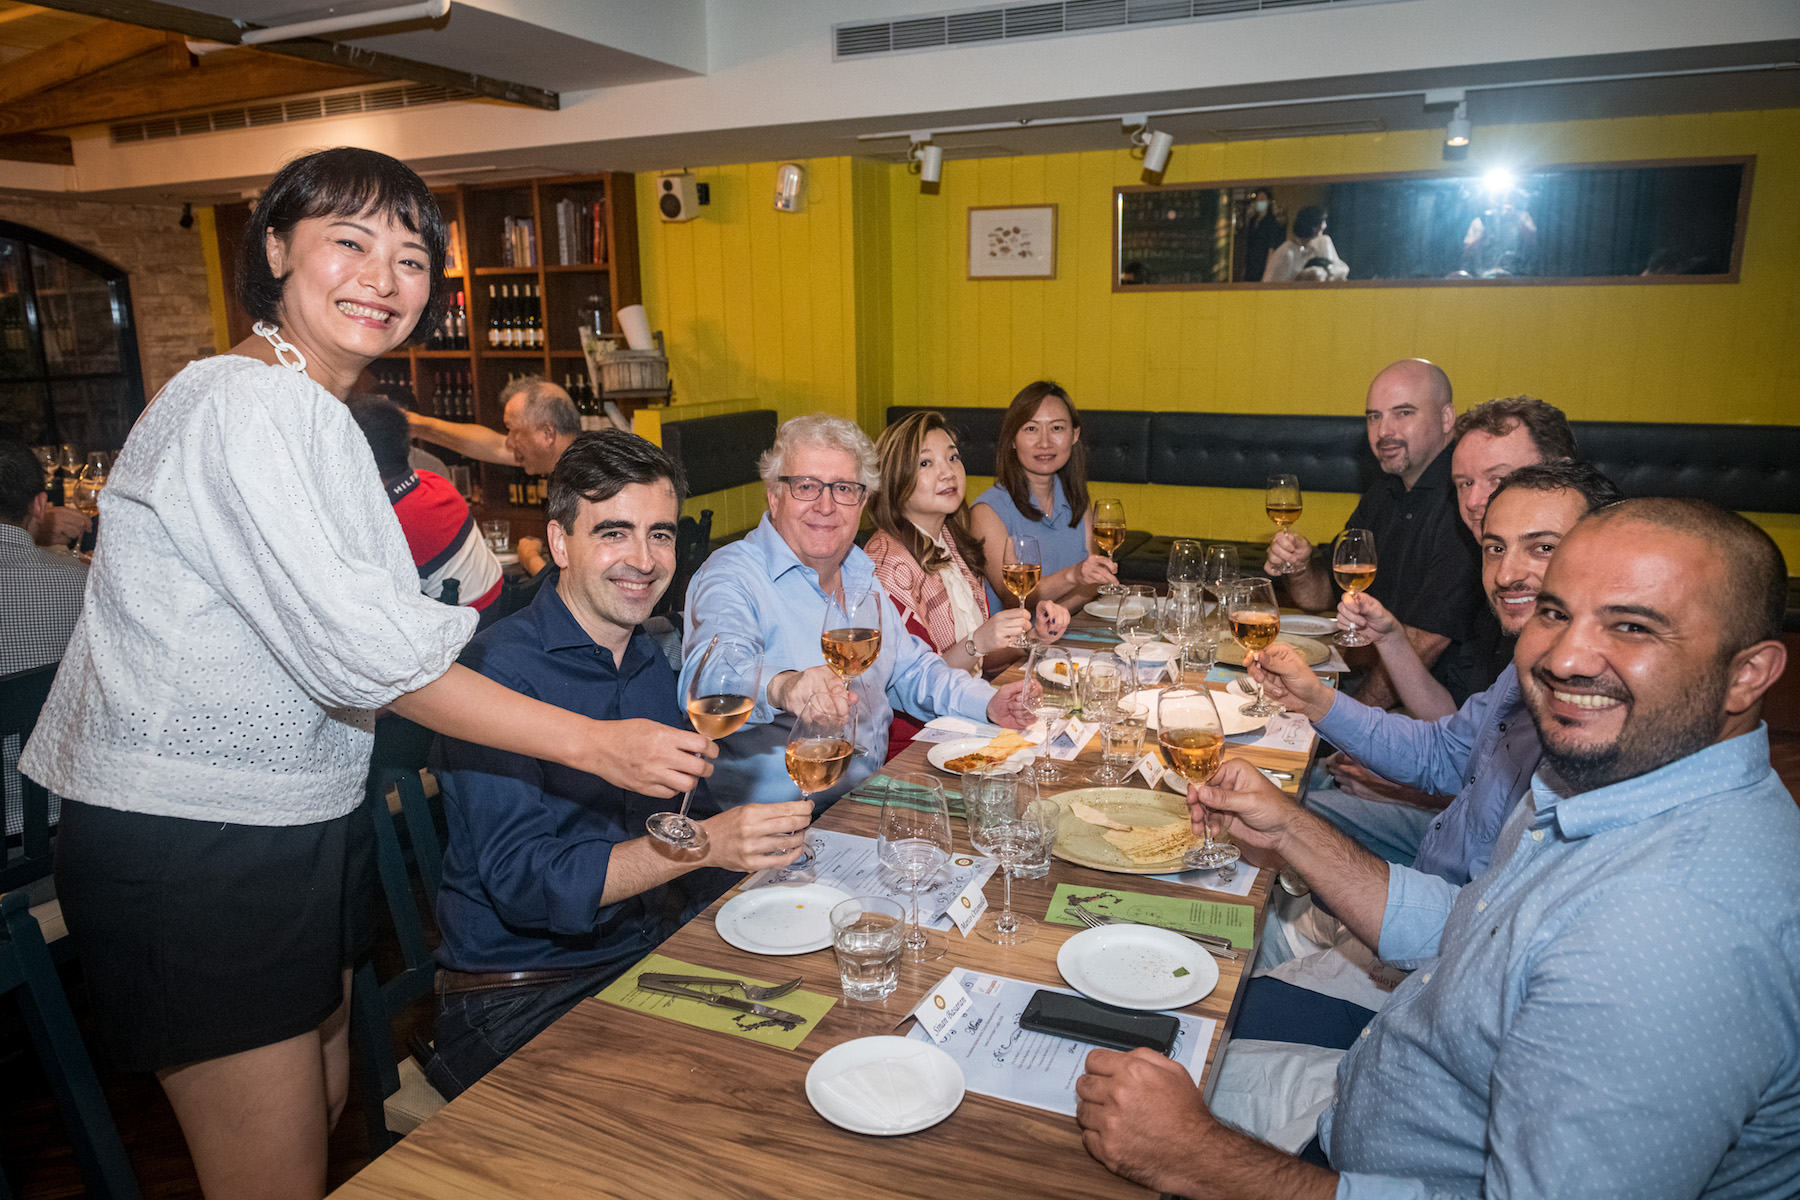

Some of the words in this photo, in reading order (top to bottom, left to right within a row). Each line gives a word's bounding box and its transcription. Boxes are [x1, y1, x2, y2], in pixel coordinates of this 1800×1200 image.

[933, 1017, 949, 1037] Sinan
[946, 996, 967, 1020] Basaran
[964, 1017, 983, 1036] Menu
